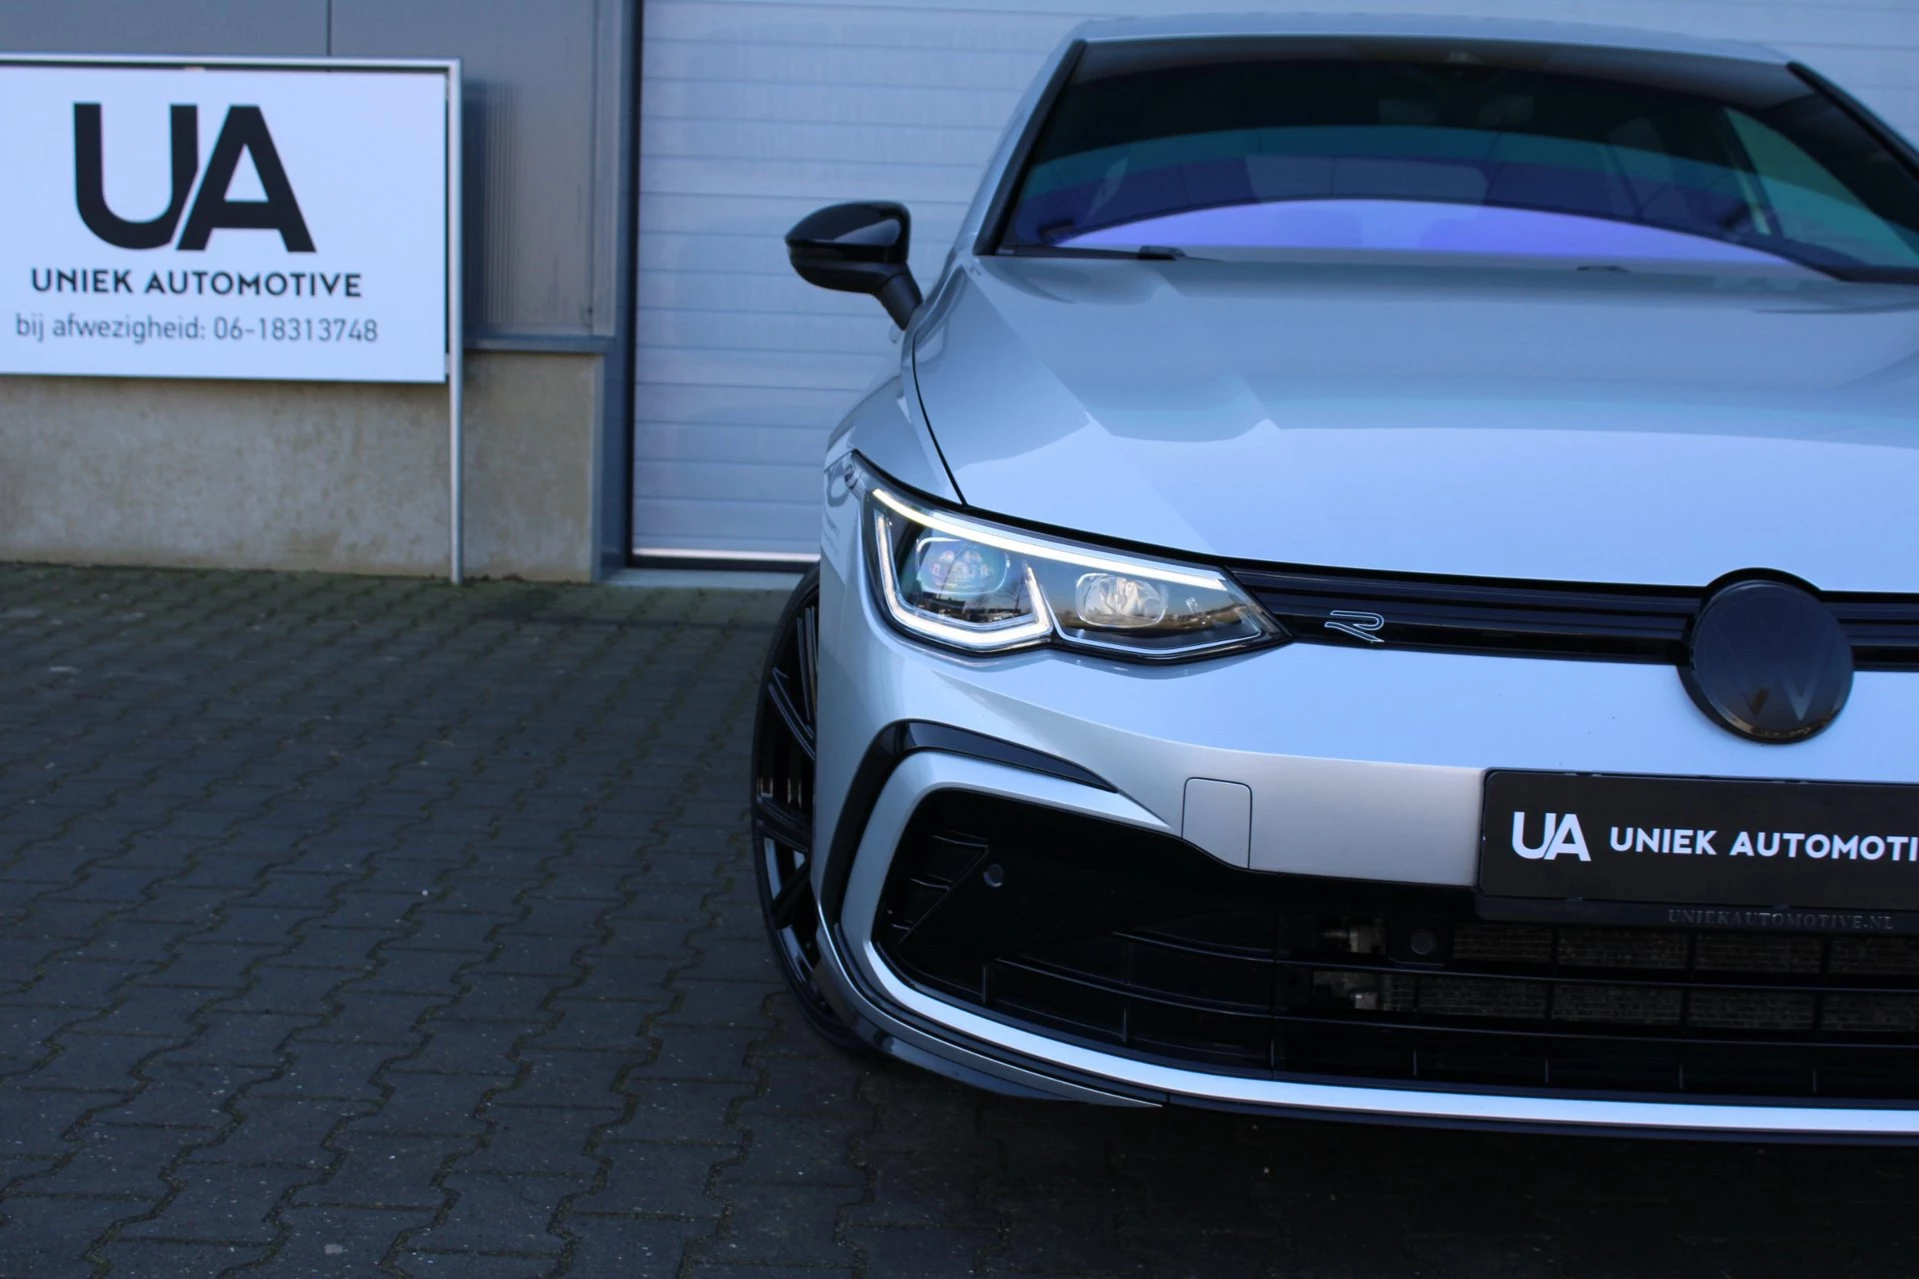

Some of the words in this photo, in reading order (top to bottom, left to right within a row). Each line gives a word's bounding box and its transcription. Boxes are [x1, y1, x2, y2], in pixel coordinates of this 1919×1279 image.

[73, 102, 317, 253] UA
[31, 268, 134, 294] UNIEK
[144, 271, 362, 298] AUTOMOTIVE
[16, 313, 44, 342] bij
[52, 313, 206, 344] afwezigheid:
[213, 316, 379, 342] 06-18313748
[1511, 811, 1592, 862] UA
[1610, 826, 1717, 855] UNIEK
[1667, 908, 1894, 930] UNIEKAUTOMOTIVE.NL
